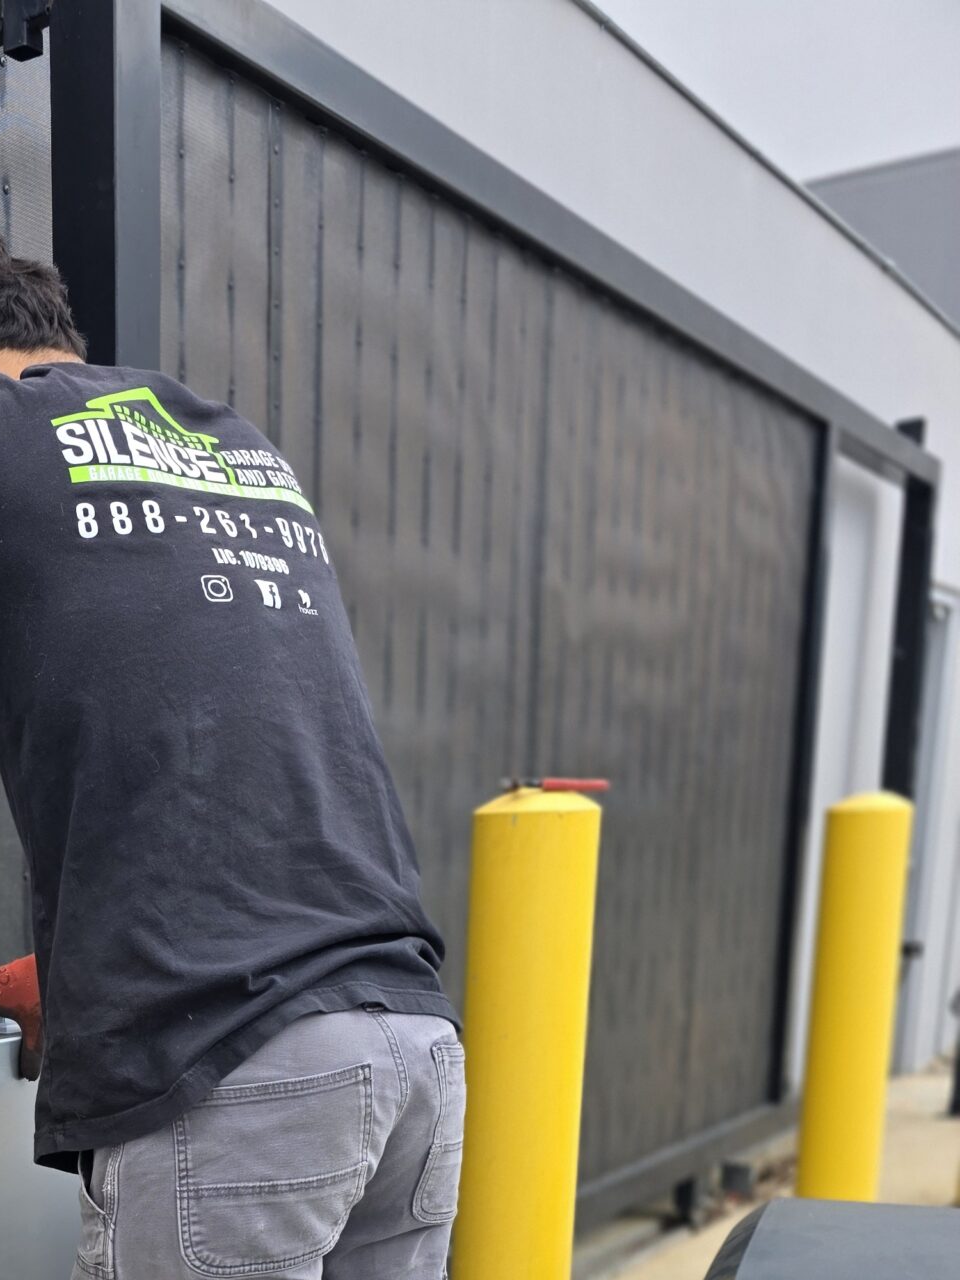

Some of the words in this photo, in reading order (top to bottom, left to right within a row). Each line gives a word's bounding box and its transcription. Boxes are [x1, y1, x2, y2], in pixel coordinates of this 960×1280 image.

[56, 418, 228, 483] SILENCE
[220, 449, 279, 468] GARAGE
[90, 465, 141, 481] GARAGE
[235, 469, 267, 487] AND
[211, 547, 241, 565] LIC.
